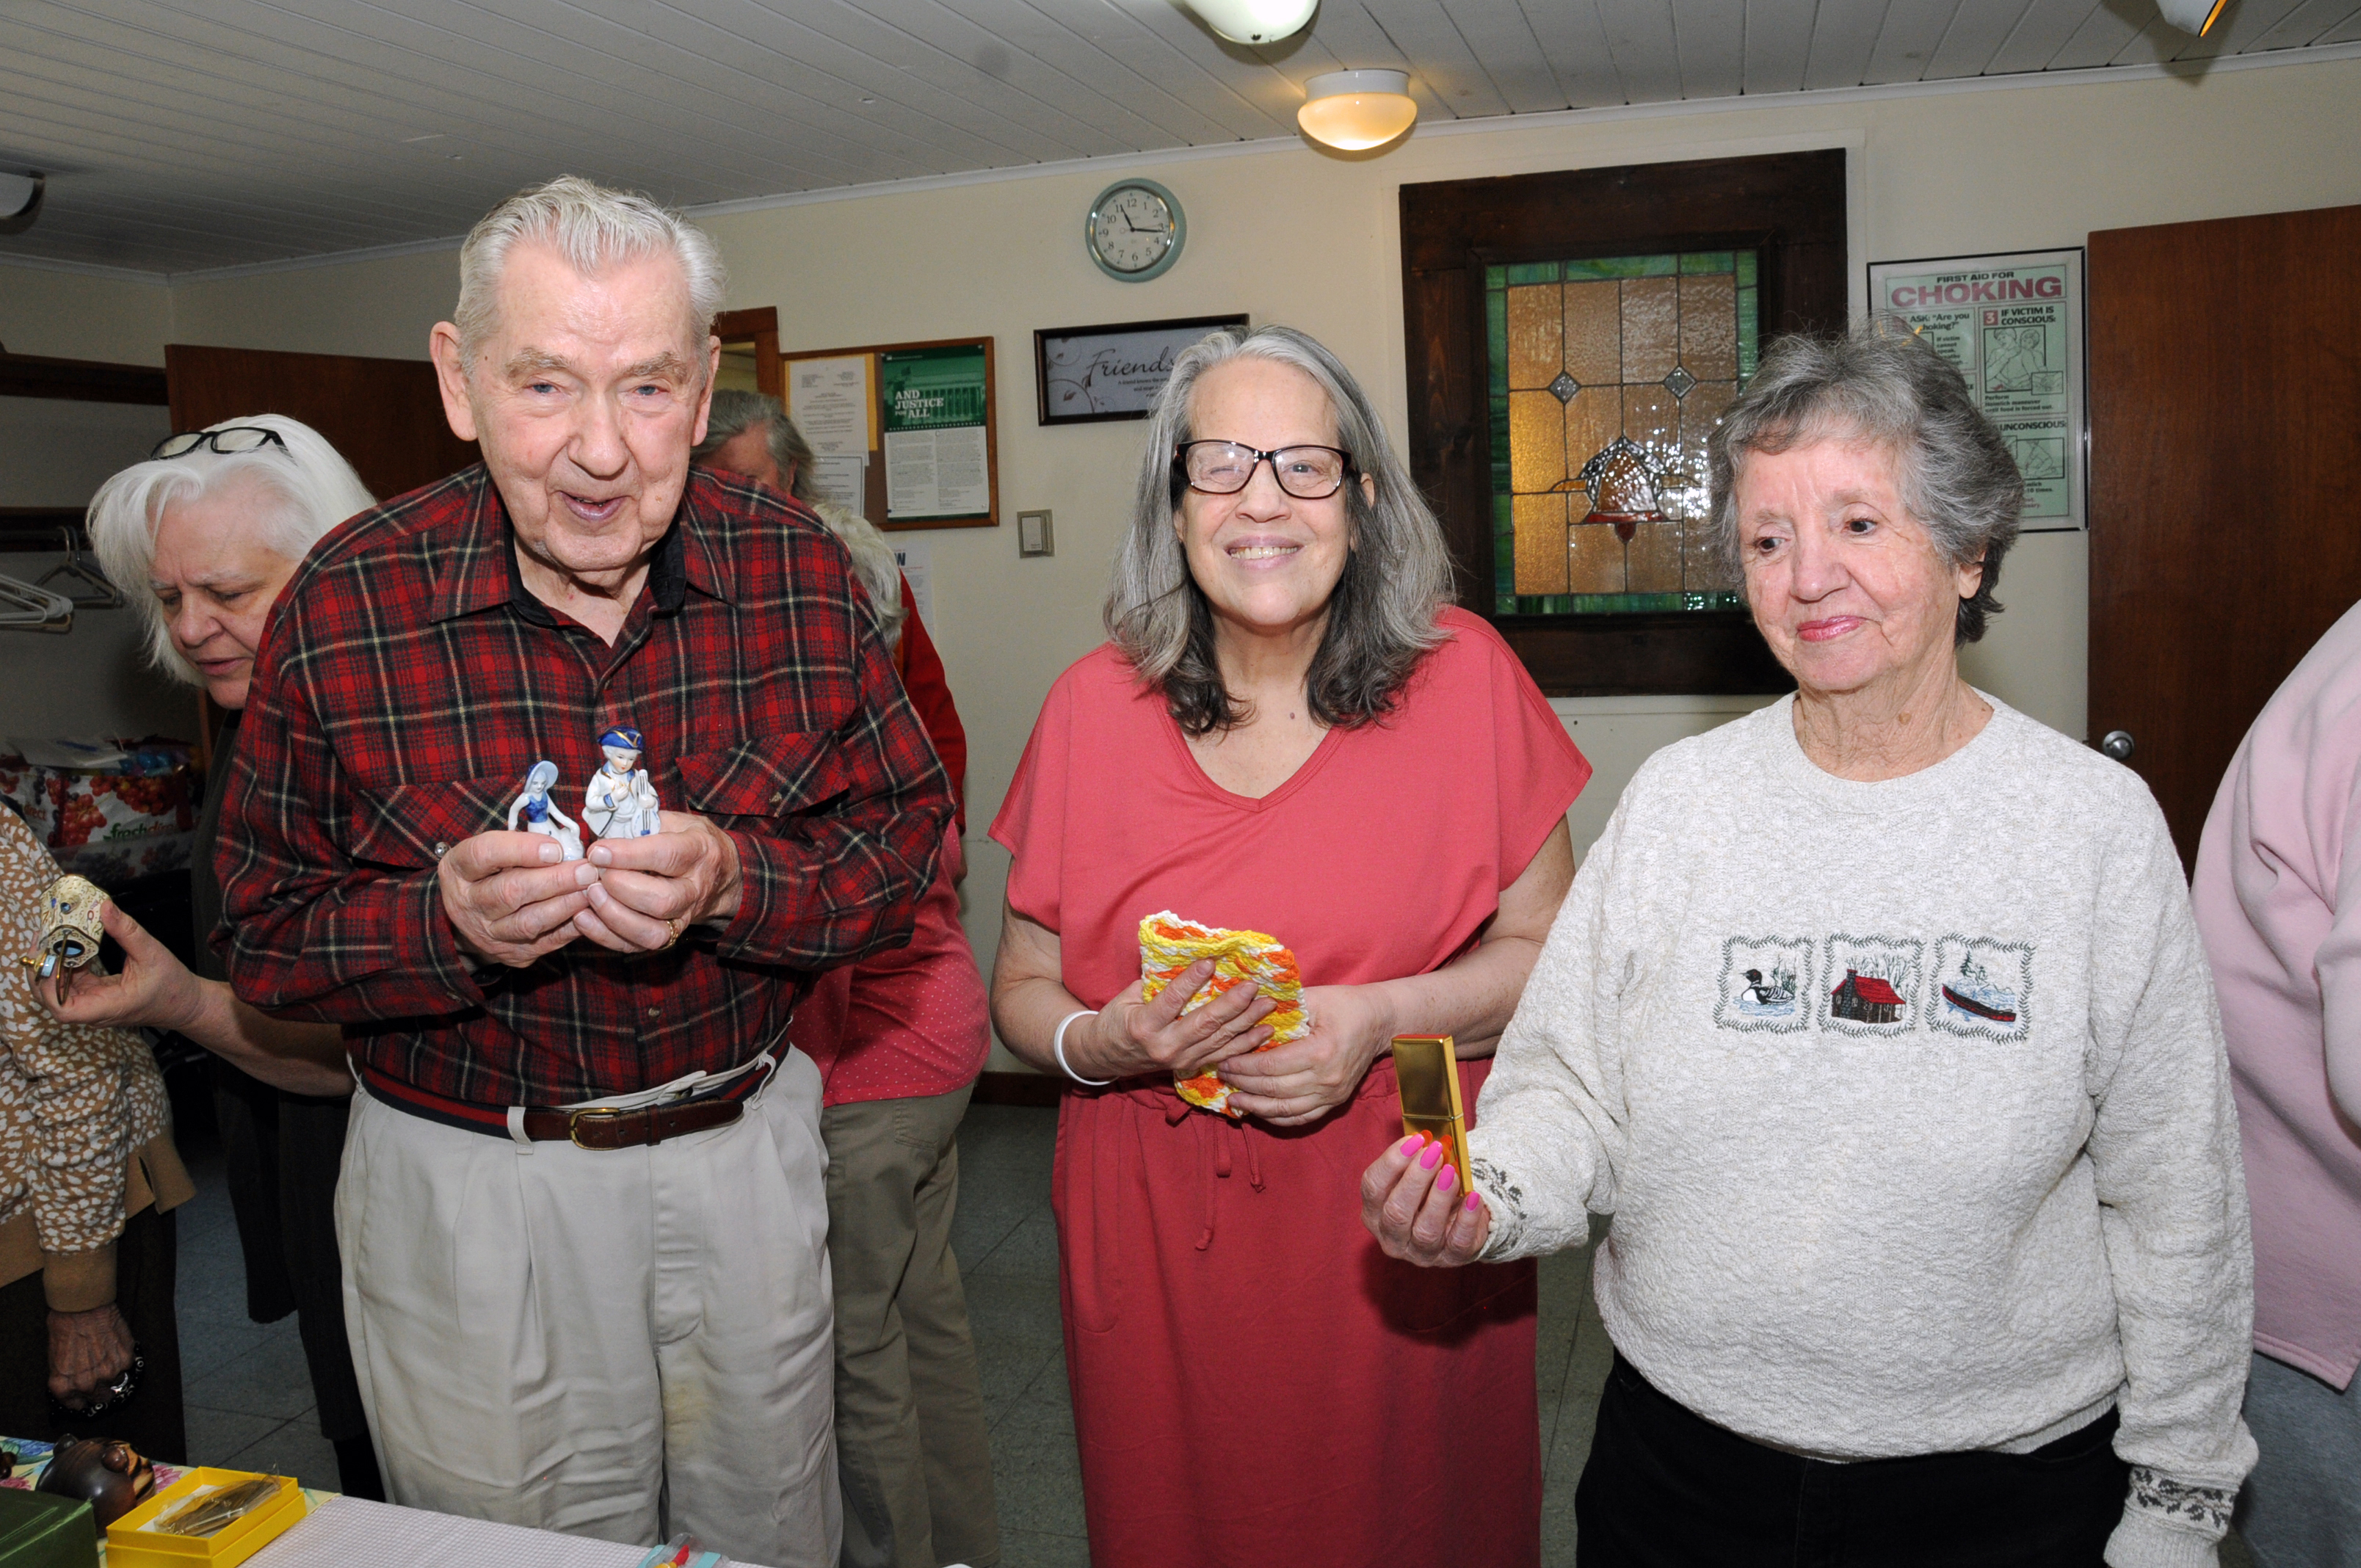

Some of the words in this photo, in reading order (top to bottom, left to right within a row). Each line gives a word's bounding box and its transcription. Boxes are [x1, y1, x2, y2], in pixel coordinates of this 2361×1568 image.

[1127, 198, 1137, 207] 12
[1144, 201, 1147, 210] 1
[1115, 204, 1124, 213] 11
[1153, 209, 1158, 218] 2
[1106, 214, 1117, 224] 10
[1158, 222, 1164, 231] 3
[1103, 228, 1109, 237] 9
[1108, 242, 1114, 250] 8
[1119, 250, 1125, 258] 7
[1145, 247, 1152, 256] 5
[1131, 253, 1138, 261] 6
[1937, 275, 1968, 283] FIRST
[1890, 276, 2063, 308] CHOKING
[2012, 307, 2043, 316] VICTIM
[1910, 314, 1930, 323] ASK:
[1954, 313, 1970, 322] you
[1986, 312, 1995, 324] 3
[2001, 315, 2056, 325] CONSCIOUS:
[1922, 321, 1959, 330] hoking?”
[895, 389, 921, 400] AND
[895, 397, 944, 410] JUSTICE
[908, 408, 930, 418] ALL
